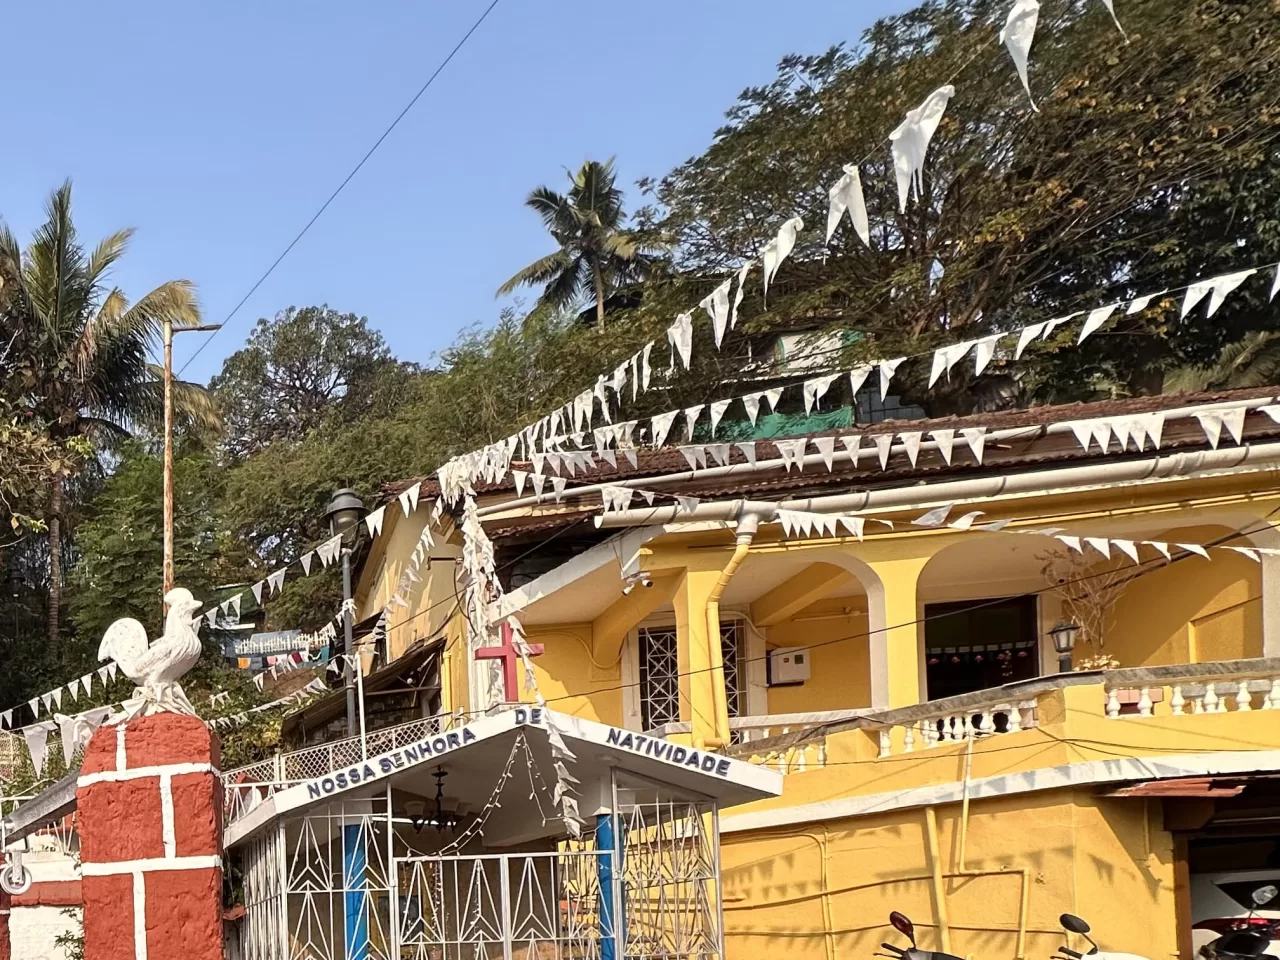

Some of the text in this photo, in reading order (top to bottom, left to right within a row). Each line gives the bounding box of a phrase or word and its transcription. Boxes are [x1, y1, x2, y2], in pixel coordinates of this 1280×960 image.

[306, 708, 731, 799] NOSSA SENHORA DE NATIVIDADE
